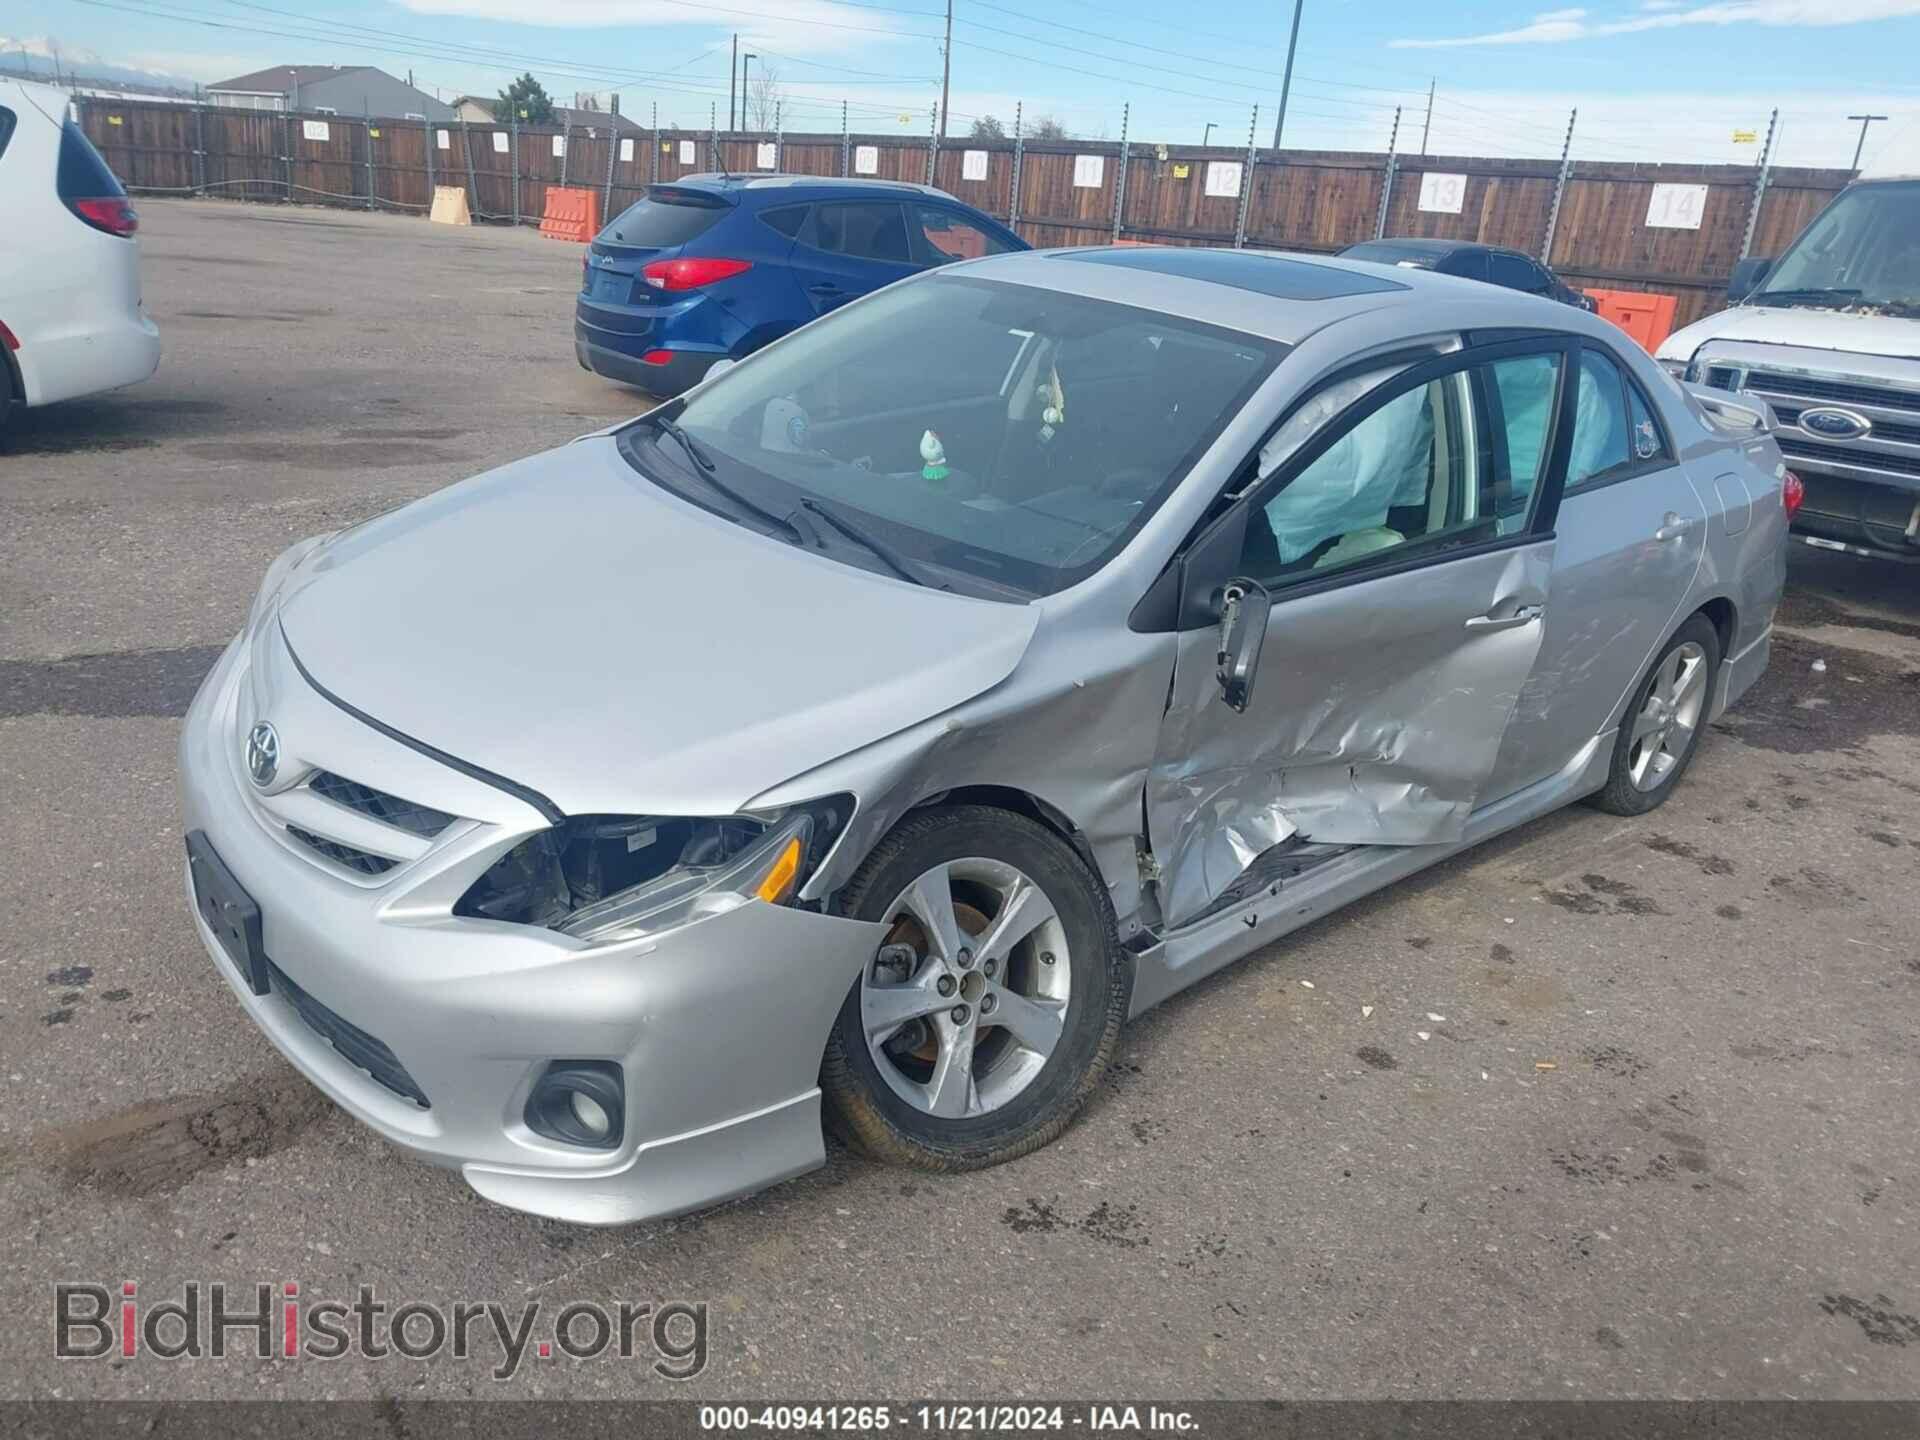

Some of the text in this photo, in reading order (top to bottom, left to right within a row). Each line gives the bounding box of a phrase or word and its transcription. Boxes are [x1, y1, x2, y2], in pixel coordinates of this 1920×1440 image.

[967, 156, 985, 177] 10
[1080, 159, 1097, 183] 11
[1214, 166, 1236, 191] 12
[1429, 178, 1457, 206] 13
[1661, 189, 1694, 221] 14
